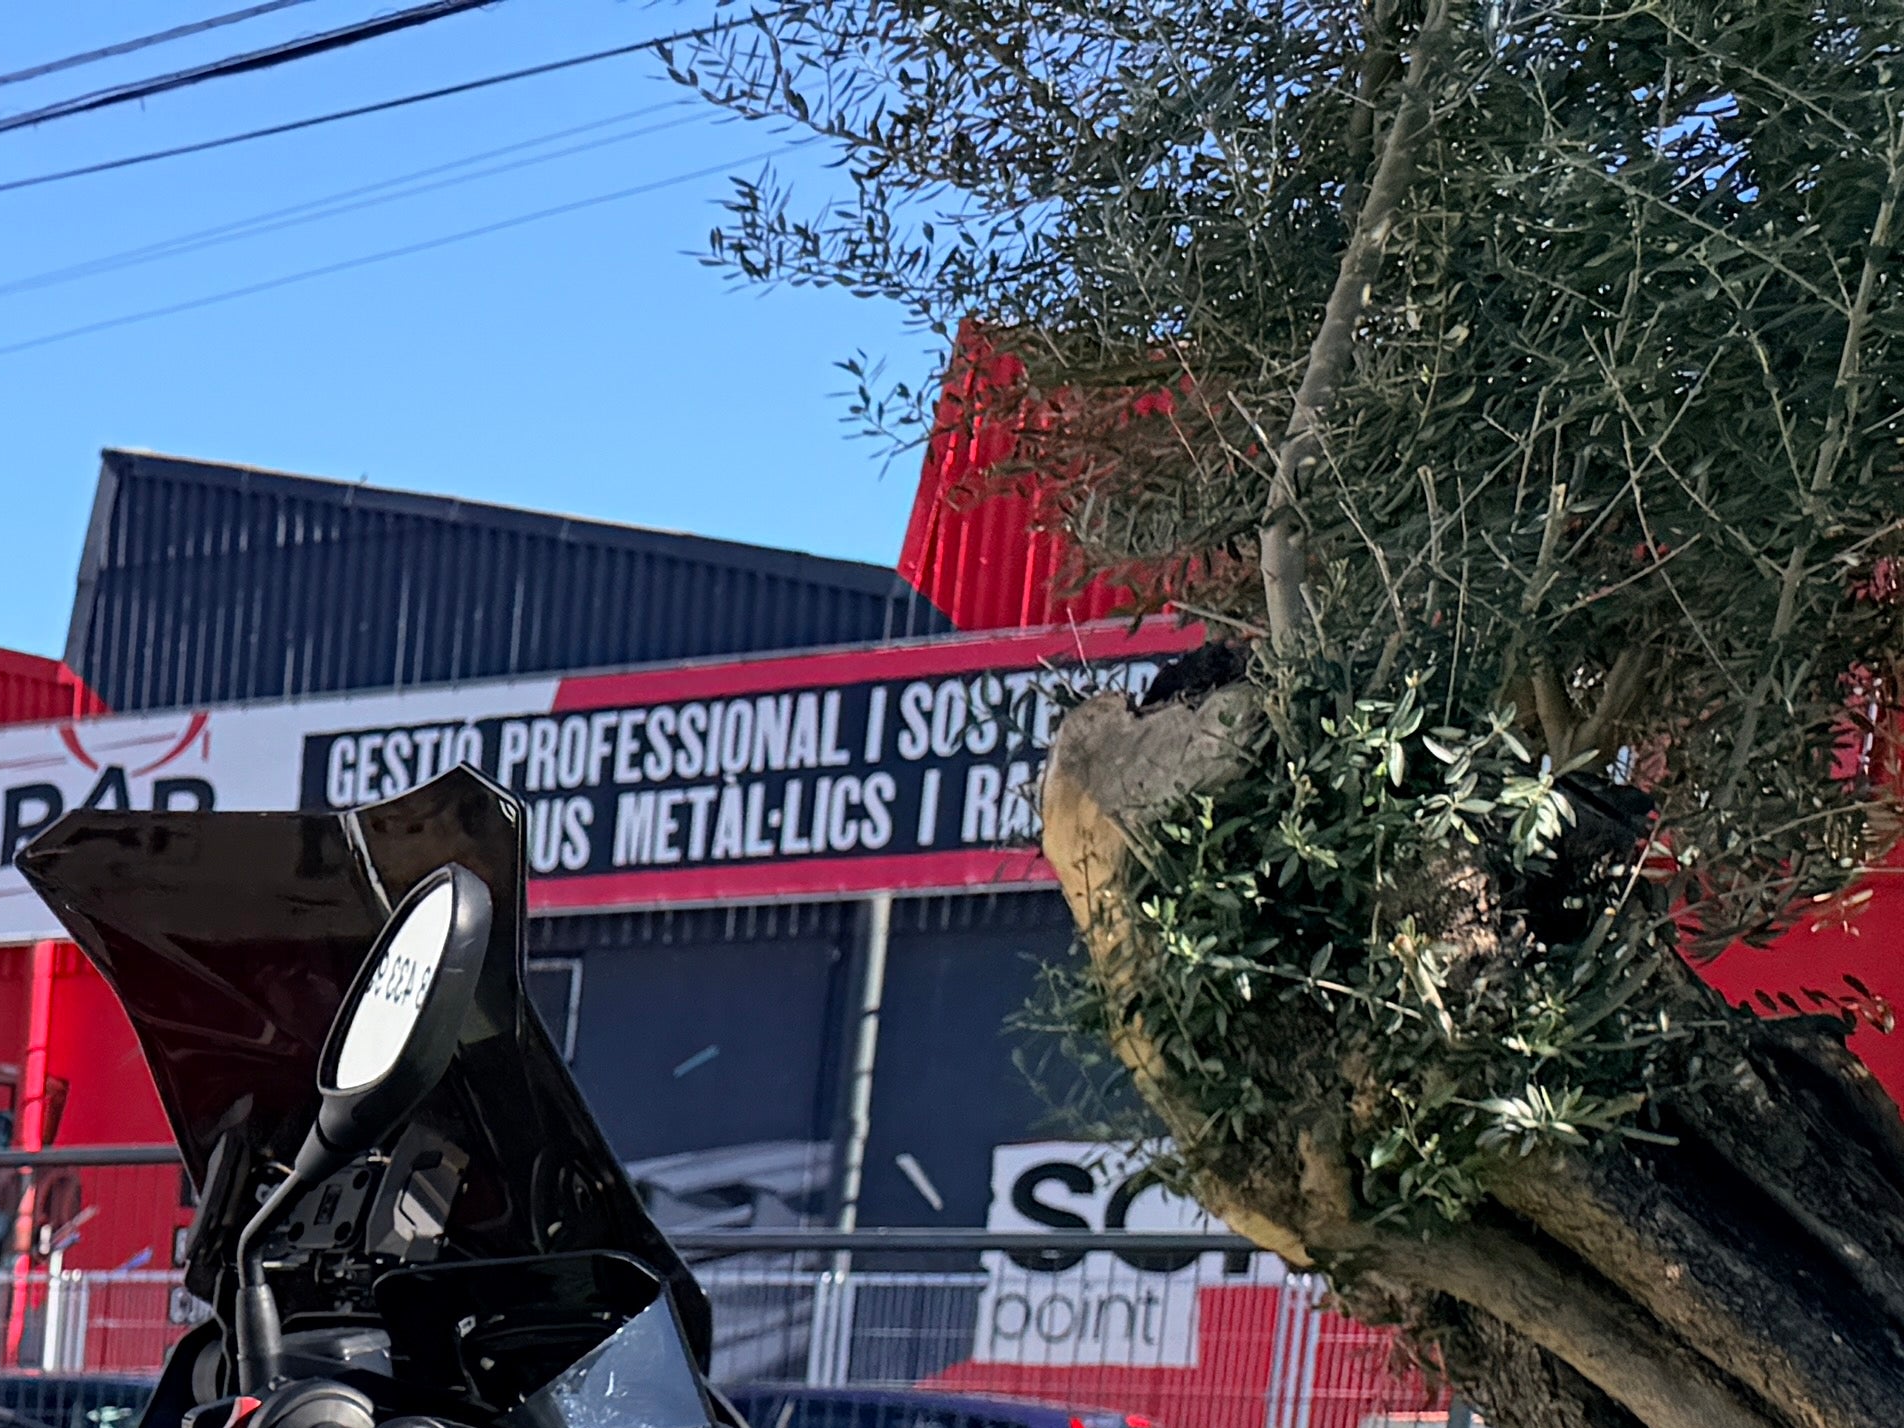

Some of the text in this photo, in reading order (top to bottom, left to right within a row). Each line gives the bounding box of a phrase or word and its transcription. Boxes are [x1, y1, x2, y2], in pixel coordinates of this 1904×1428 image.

[497, 691, 850, 791] PROFESSIONAL
[864, 685, 887, 763] I
[917, 767, 941, 846] I
[992, 1285, 1162, 1350] point
